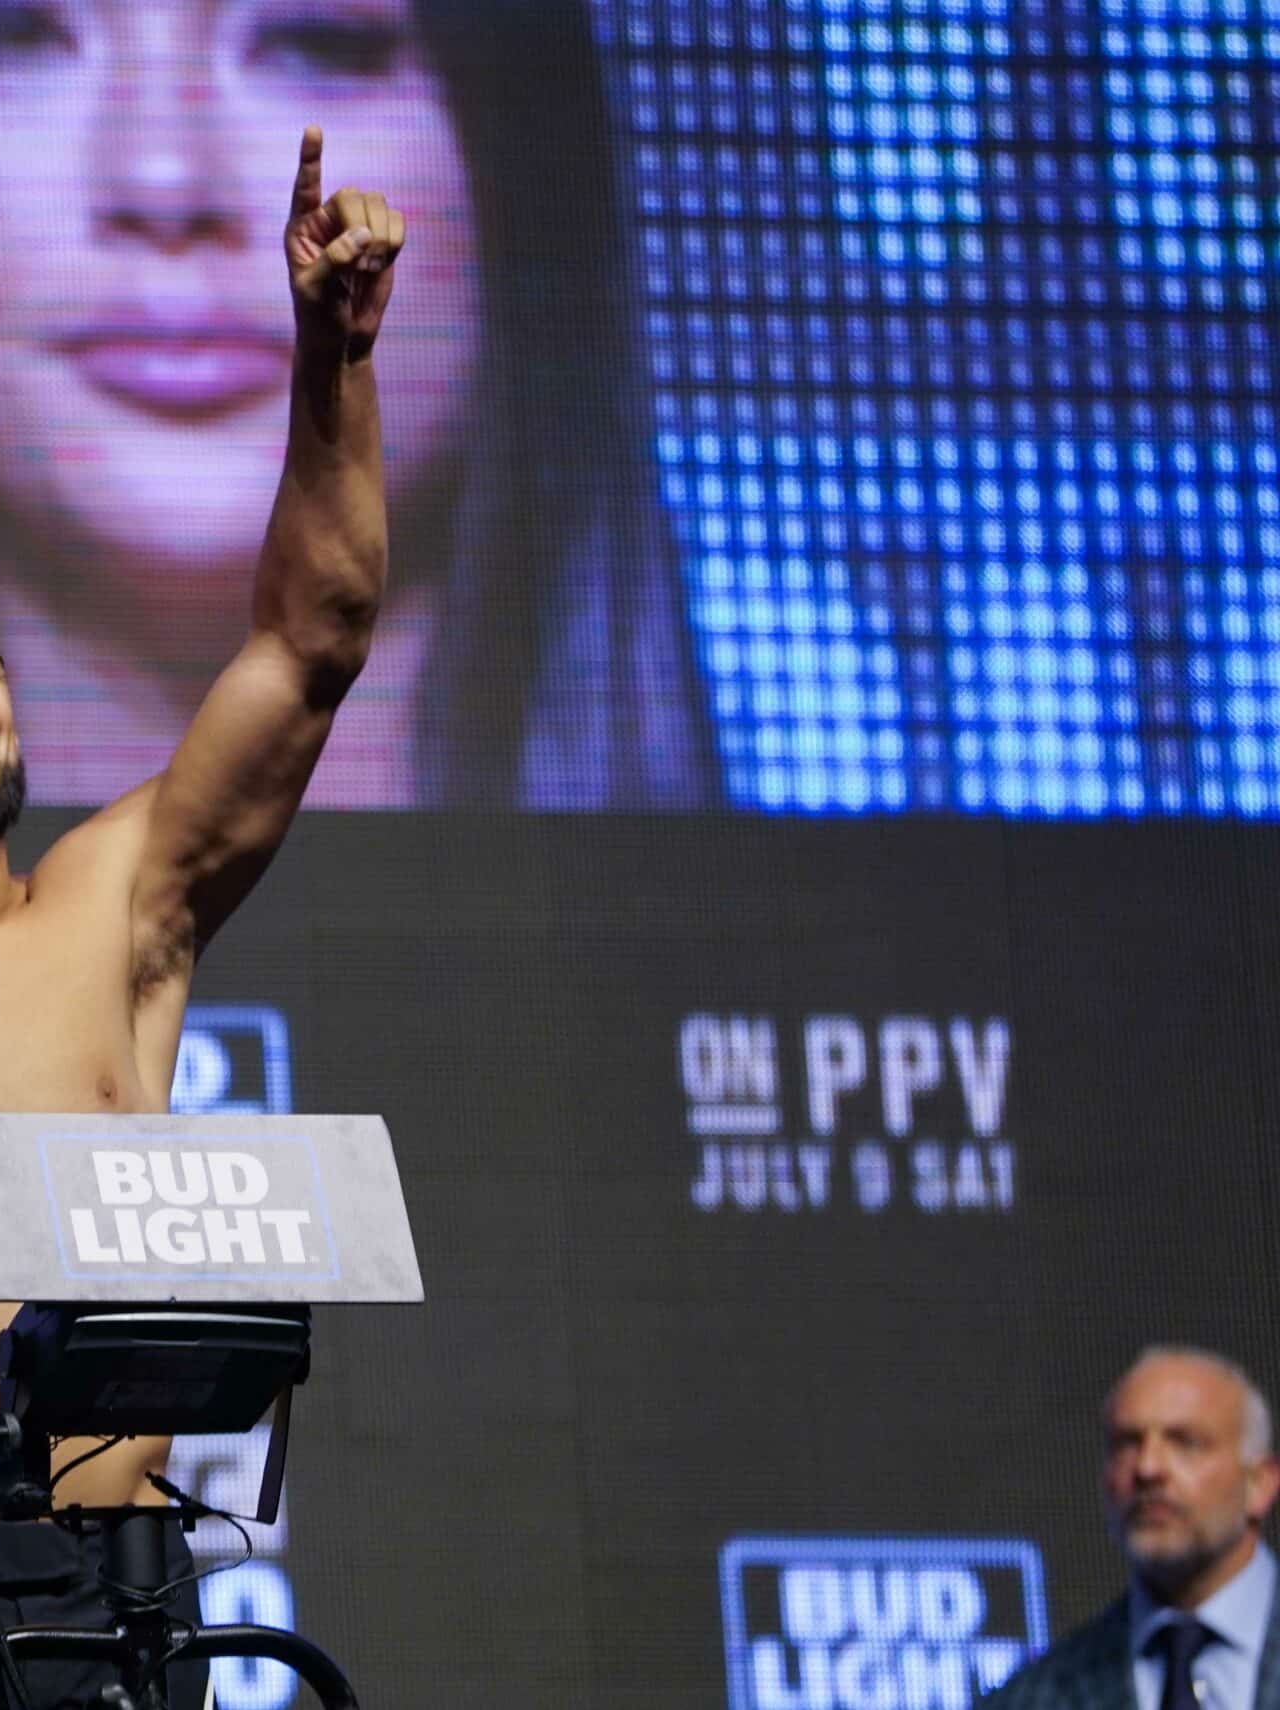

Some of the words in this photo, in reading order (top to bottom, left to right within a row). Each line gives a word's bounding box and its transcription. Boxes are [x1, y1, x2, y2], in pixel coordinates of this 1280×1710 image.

[680, 1014, 778, 1099] ON
[803, 1013, 1012, 1137] PPV
[91, 1150, 270, 1206] BUD
[691, 1141, 833, 1212] JULY
[909, 1141, 1016, 1212] SAT
[70, 1207, 312, 1264] LIGHT
[778, 1565, 987, 1642] BUD
